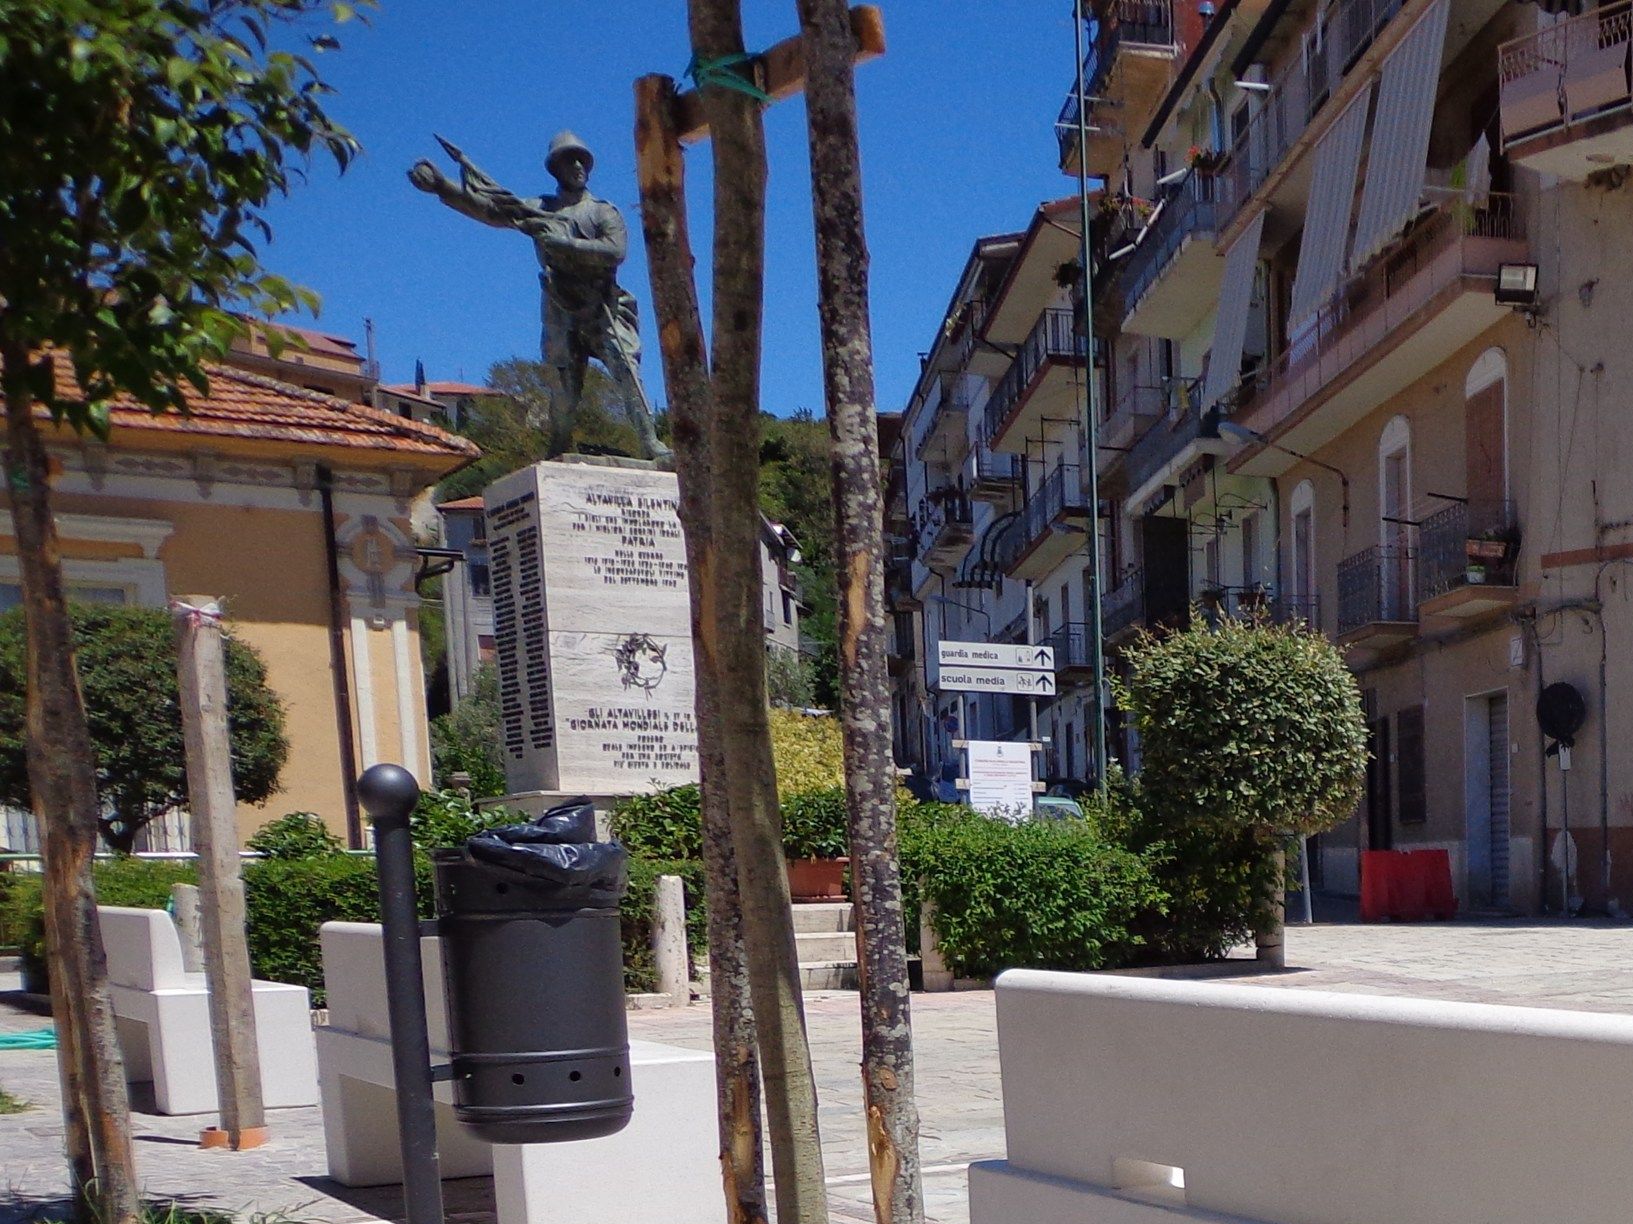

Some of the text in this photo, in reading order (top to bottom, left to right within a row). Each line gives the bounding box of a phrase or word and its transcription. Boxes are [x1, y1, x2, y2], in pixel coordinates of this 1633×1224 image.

[621, 535, 655, 547] PATRIA
[941, 649, 999, 660] guardia medica
[941, 674, 1005, 686] scuola media
[622, 721, 668, 732] MONDIALE
